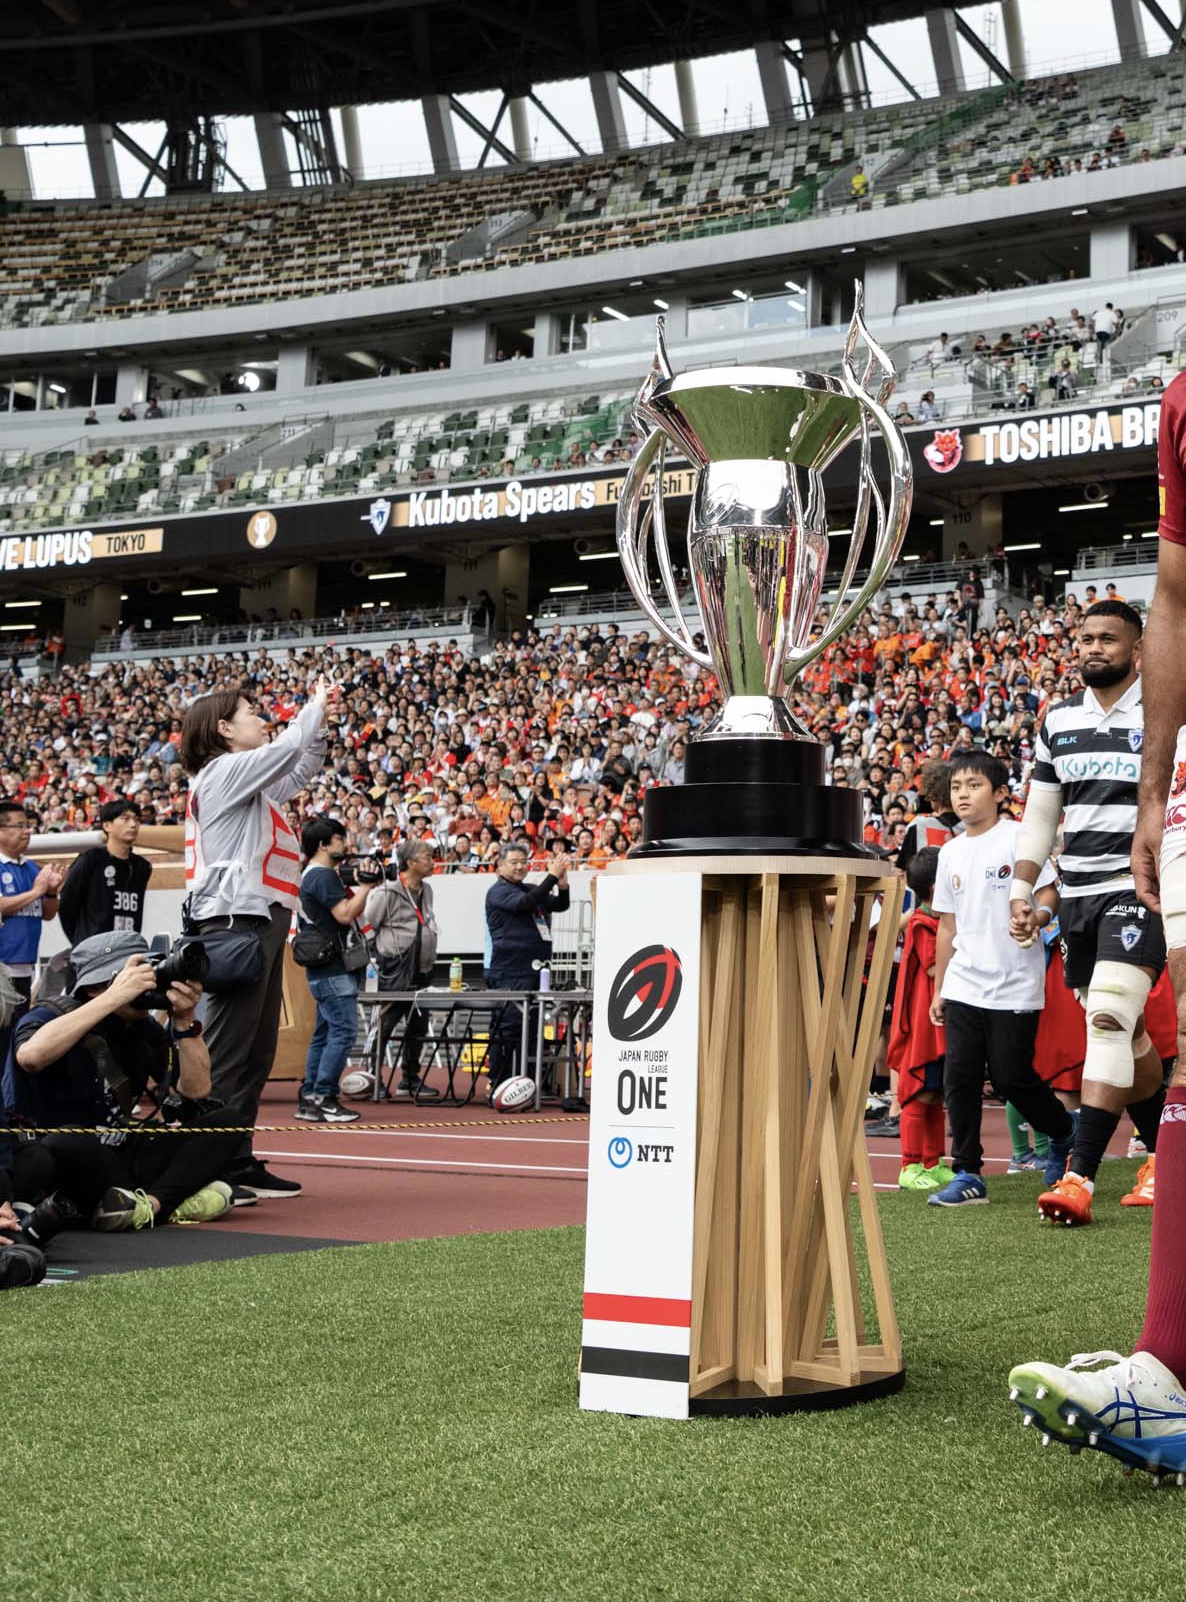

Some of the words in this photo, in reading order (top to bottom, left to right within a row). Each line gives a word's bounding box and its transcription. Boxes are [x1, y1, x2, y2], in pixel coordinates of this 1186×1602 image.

[979, 410, 1114, 466] TOSHIBA
[408, 487, 498, 528] Kubota
[505, 481, 595, 523] Spears
[23, 530, 94, 570] LUPUS
[106, 534, 146, 554] TOKYO
[1060, 756, 1137, 778] Kubota
[113, 890, 138, 912] 386
[618, 1051, 641, 1062] JAPAN
[644, 1051, 668, 1062] RUGBY
[647, 1064, 668, 1074] LEAGUE
[617, 1069, 668, 1116] ONE
[637, 1144, 674, 1163] NTT
